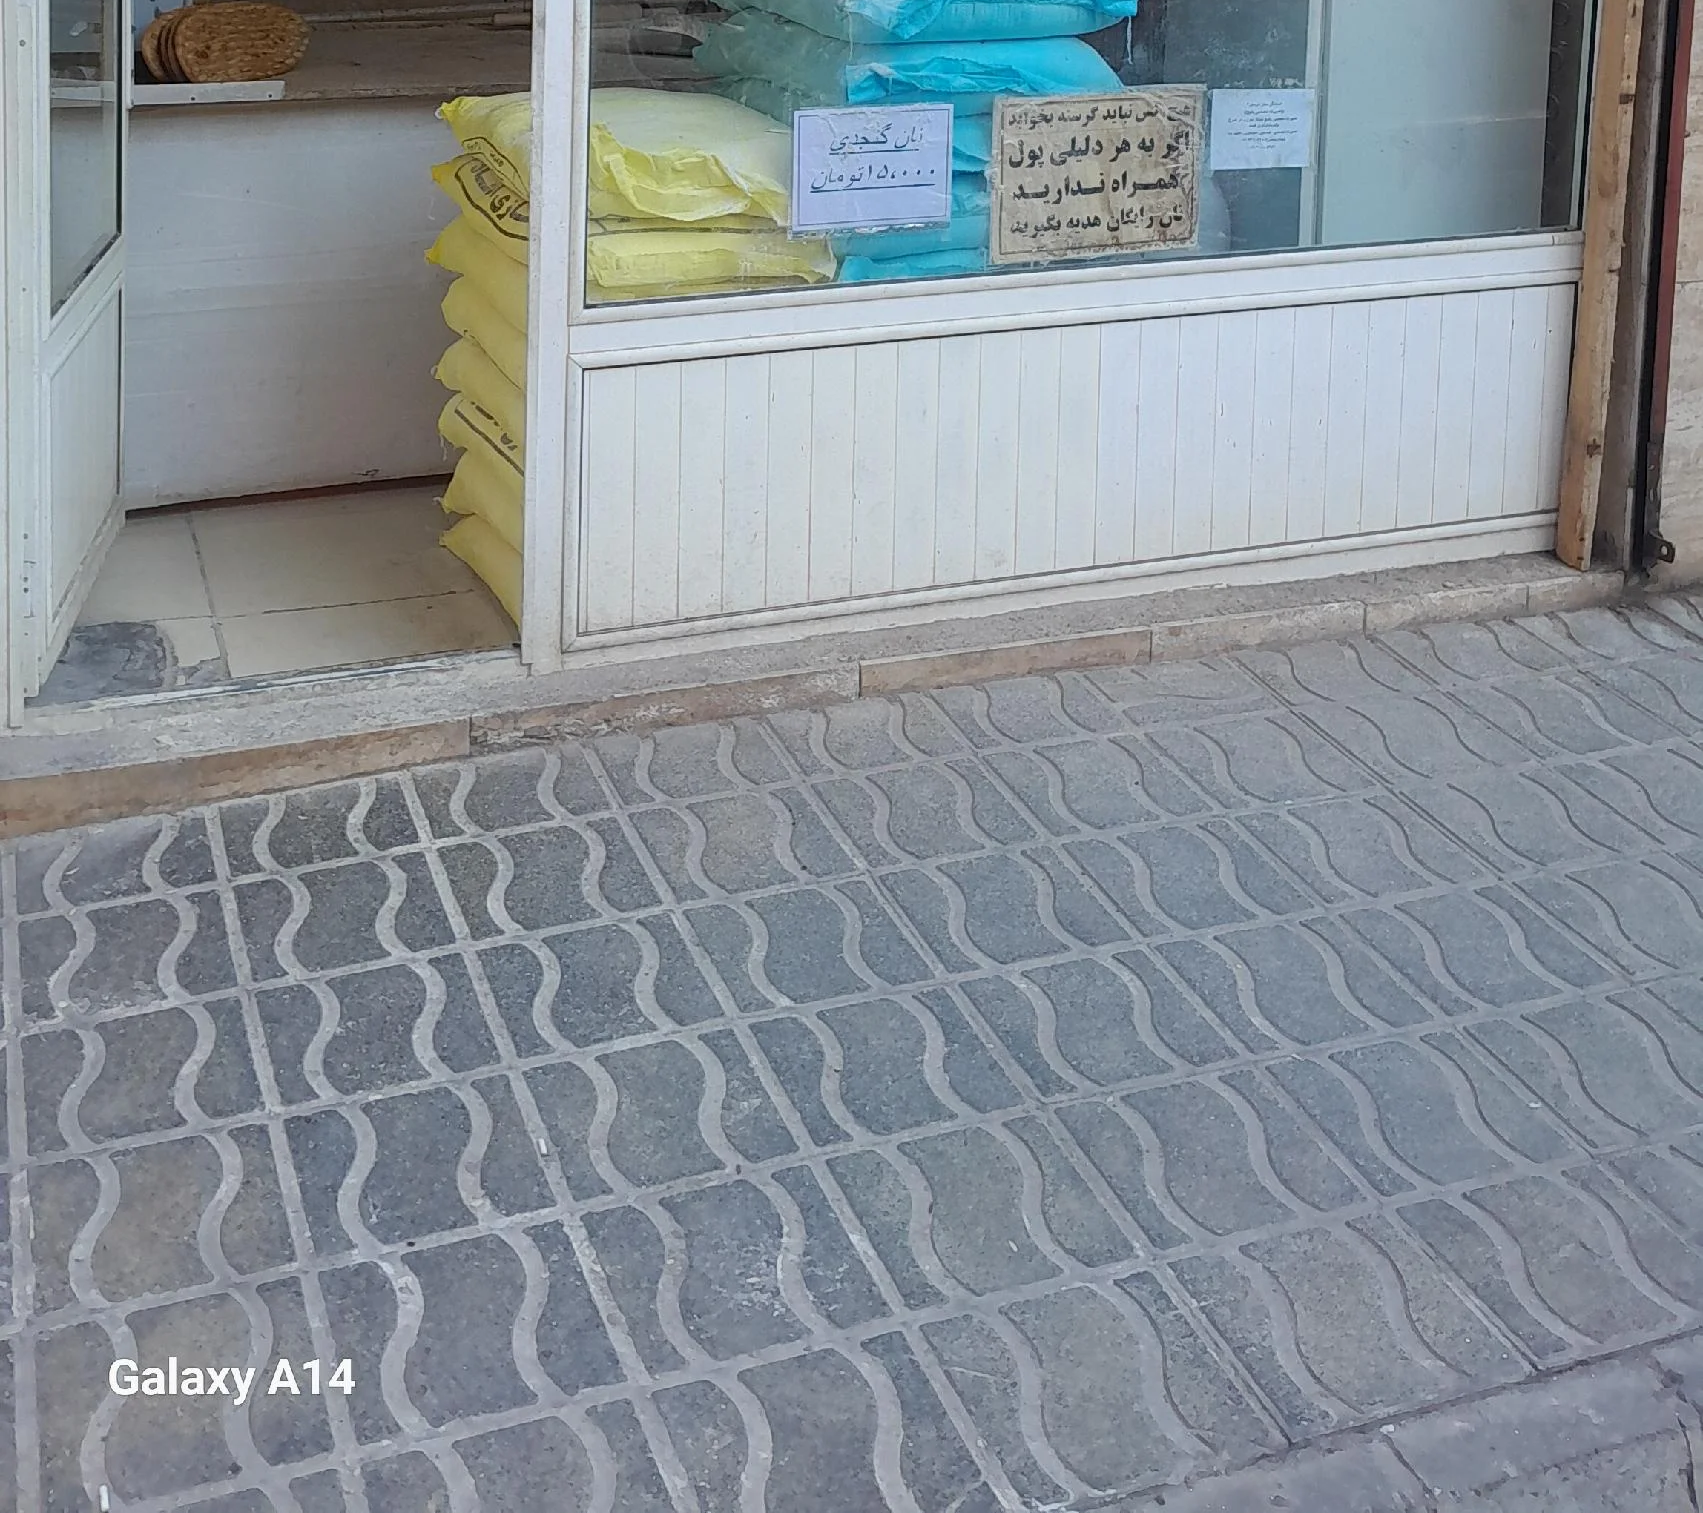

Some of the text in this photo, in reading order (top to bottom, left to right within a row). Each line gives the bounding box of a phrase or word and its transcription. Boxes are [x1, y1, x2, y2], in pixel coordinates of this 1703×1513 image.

[1057, 106, 1099, 128] گرسنه
[1102, 104, 1132, 125] نباید
[894, 126, 924, 149] نان
[1049, 134, 1104, 165] دلیلی
[1137, 136, 1155, 158] به
[1008, 139, 1045, 169] پول
[1108, 137, 1131, 163] هر
[1012, 170, 1179, 205] همراه ندارید
[1065, 215, 1102, 234] هدیه
[1106, 206, 1154, 232] رایگان
